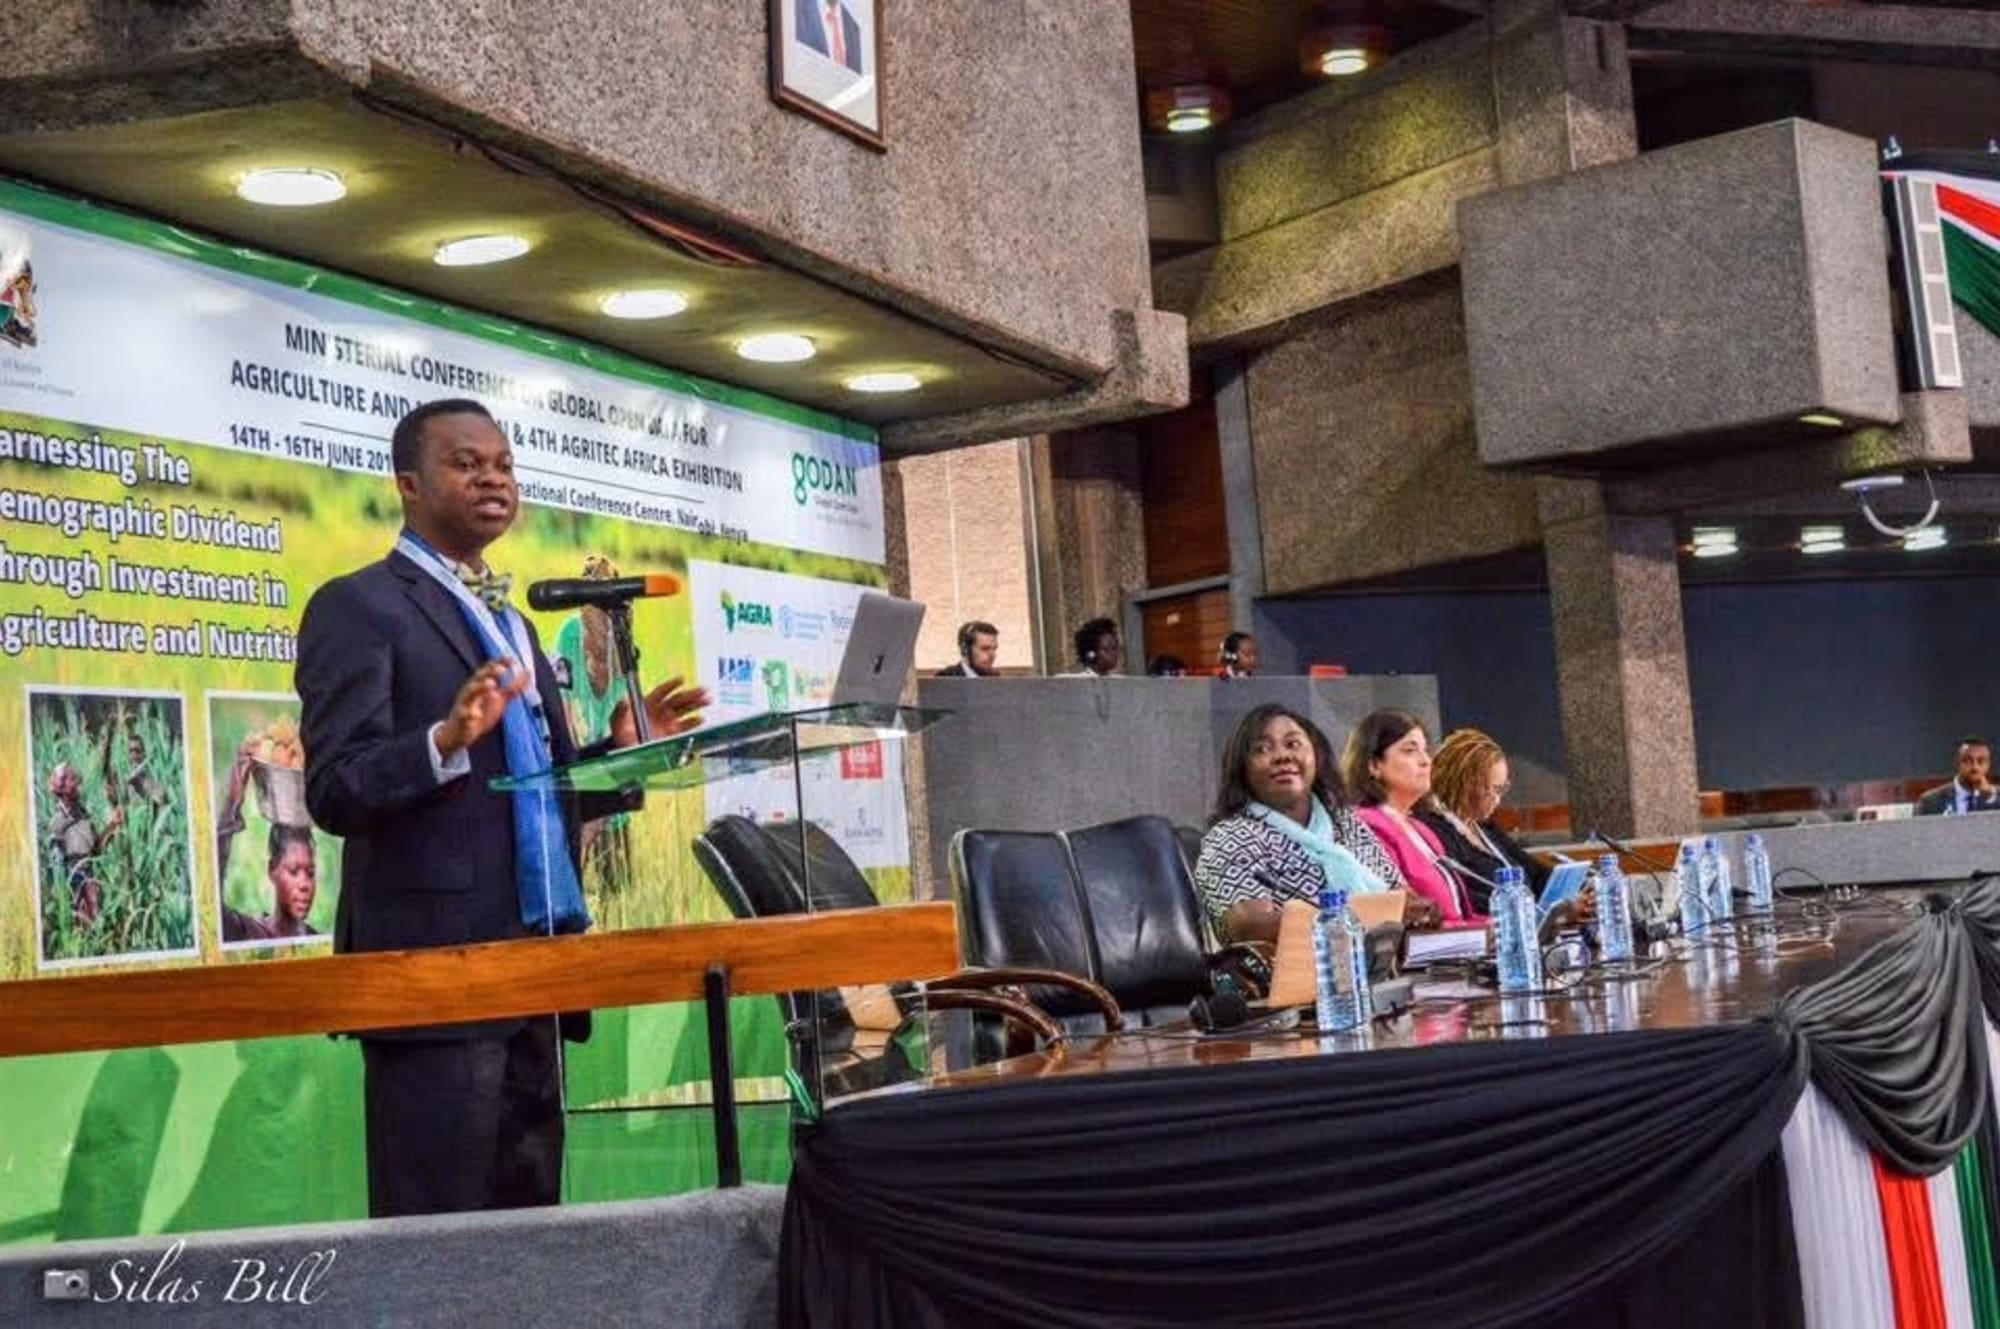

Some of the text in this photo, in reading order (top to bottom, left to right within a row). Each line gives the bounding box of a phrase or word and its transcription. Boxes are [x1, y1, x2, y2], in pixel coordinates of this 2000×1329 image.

[231, 360, 411, 421] AGRICULTURE AND
[548, 388, 605, 424] GLOBAL
[683, 423, 708, 447] FOR
[0, 428, 192, 486] arnessing The
[230, 424, 271, 451] 14TH
[284, 435, 323, 460] 16TH
[327, 442, 363, 468] JUNE
[367, 450, 392, 472] 201
[513, 423, 525, 446] &
[529, 427, 557, 453] 4TH
[561, 434, 619, 467] AGRITEC
[622, 447, 671, 478] AFRICA
[672, 458, 743, 493] EXHIBITION
[0, 488, 282, 553] emographic Dividend
[570, 488, 632, 516] Conference
[0, 541, 288, 607] hrough Investment in
[0, 605, 146, 656] griculture
[152, 619, 201, 658] and
[738, 601, 773, 629] AGRA
